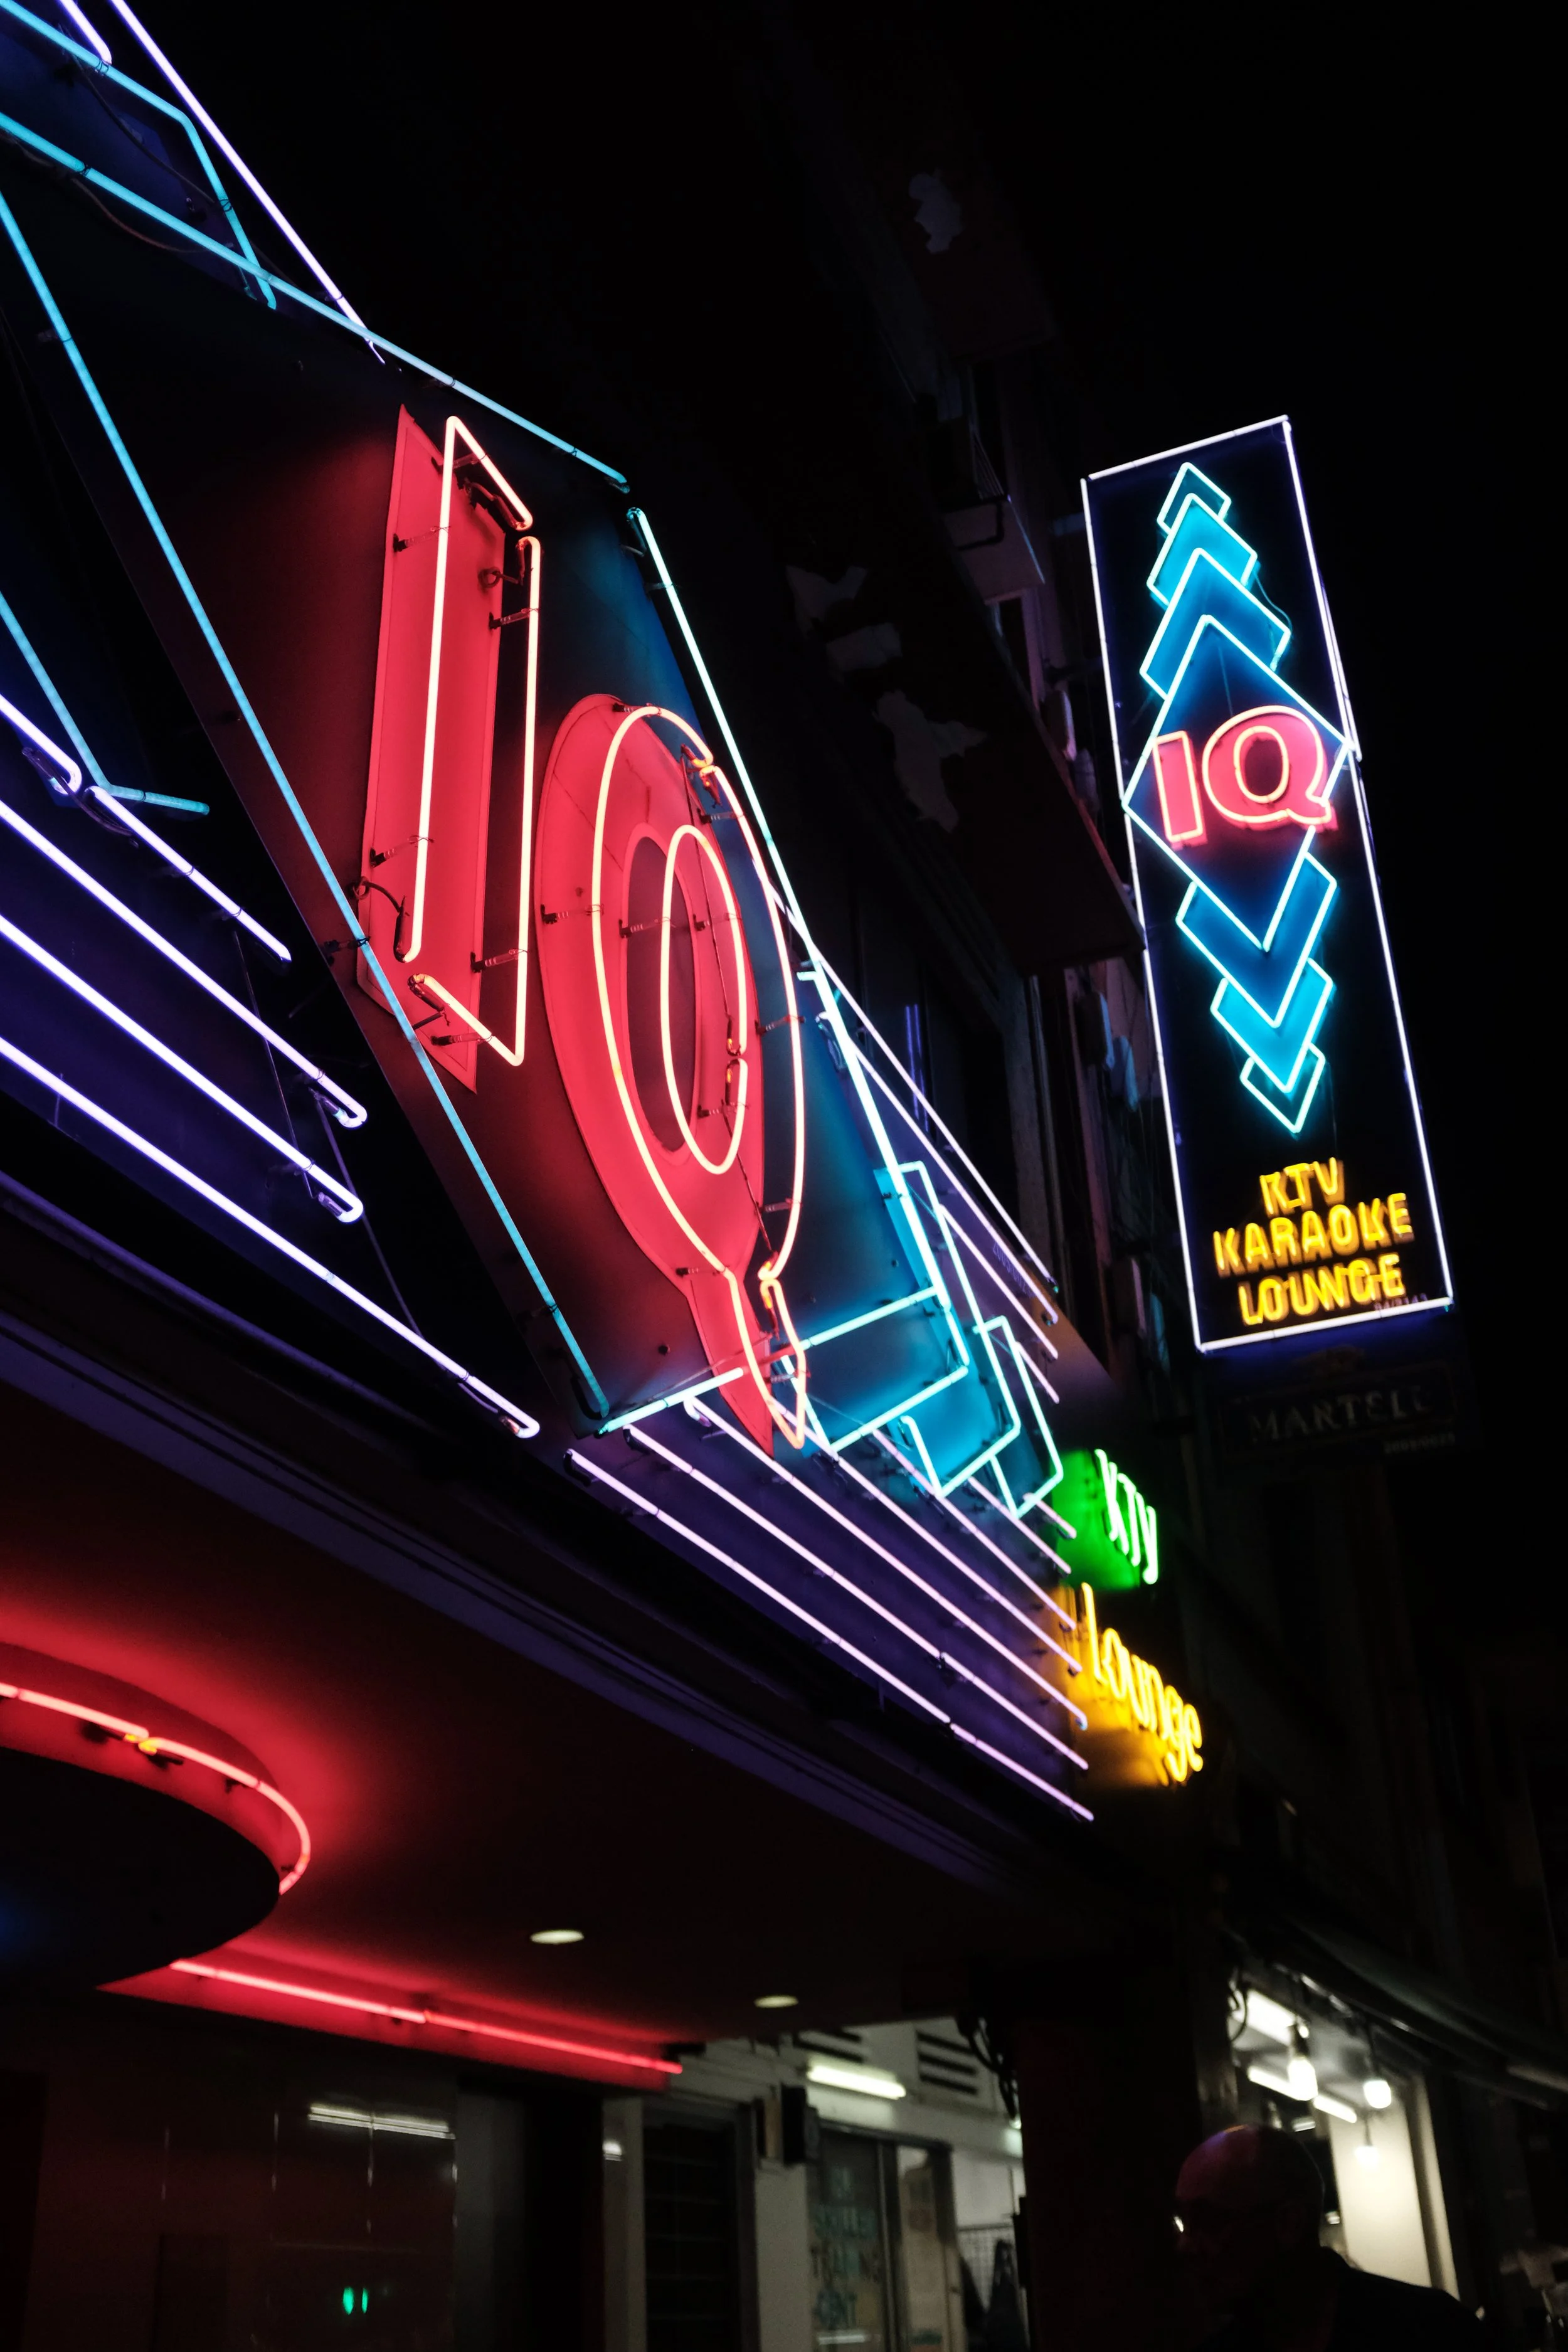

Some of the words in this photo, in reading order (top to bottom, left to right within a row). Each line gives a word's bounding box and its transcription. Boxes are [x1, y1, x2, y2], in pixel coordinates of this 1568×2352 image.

[1152, 705, 1338, 851] IQ
[358, 405, 807, 1458] IQ
[1259, 1157, 1345, 1218] KTV
[1212, 1192, 1415, 1278] KARAOKE
[1237, 1252, 1406, 1325] LOUNGE
